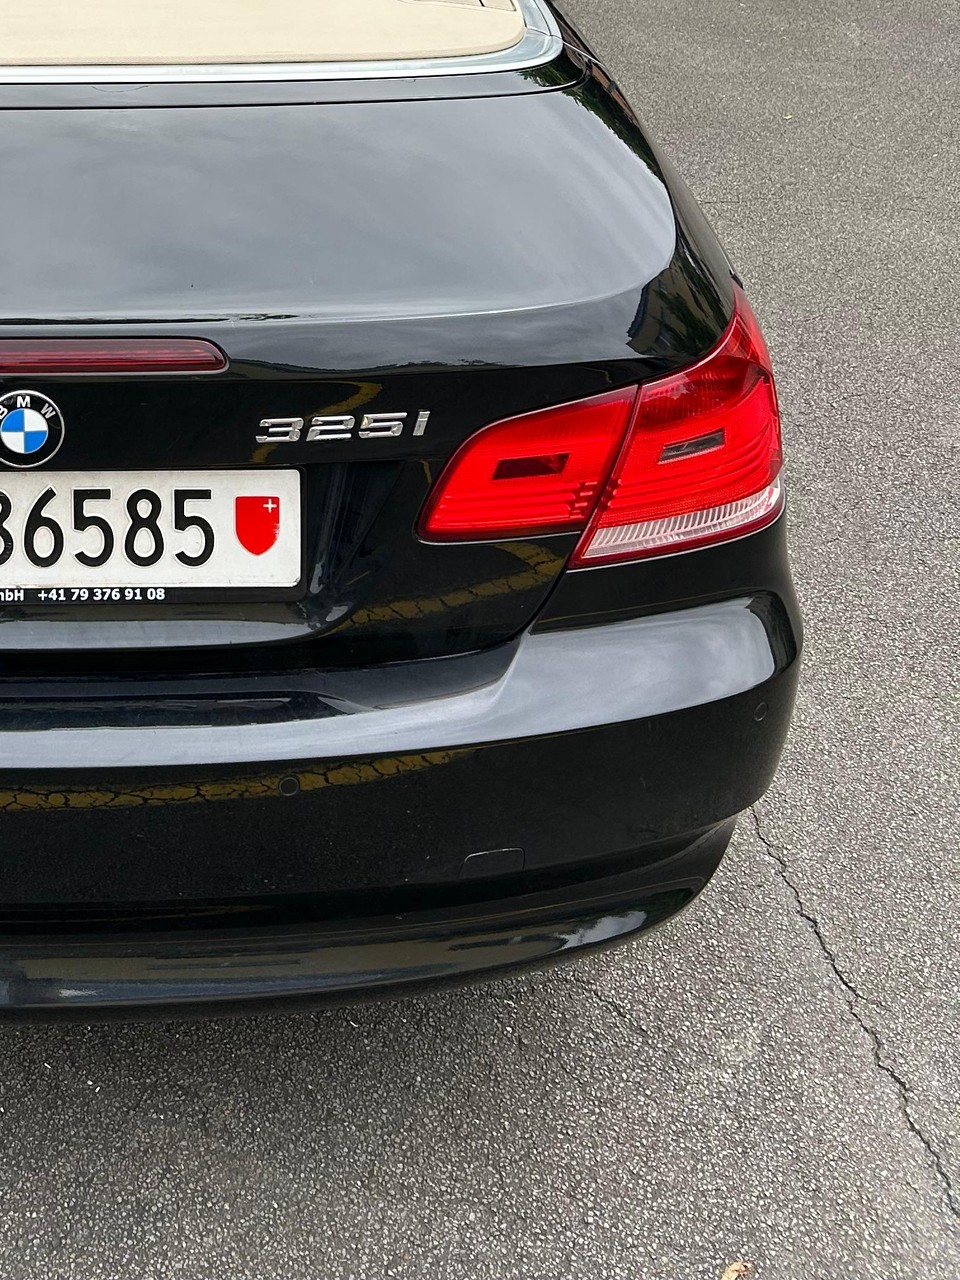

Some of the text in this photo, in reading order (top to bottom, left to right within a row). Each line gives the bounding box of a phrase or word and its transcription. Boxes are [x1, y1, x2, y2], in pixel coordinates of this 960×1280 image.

[255, 410, 431, 444] 325i
[37, 588, 166, 601] +41 79 376 91 08
